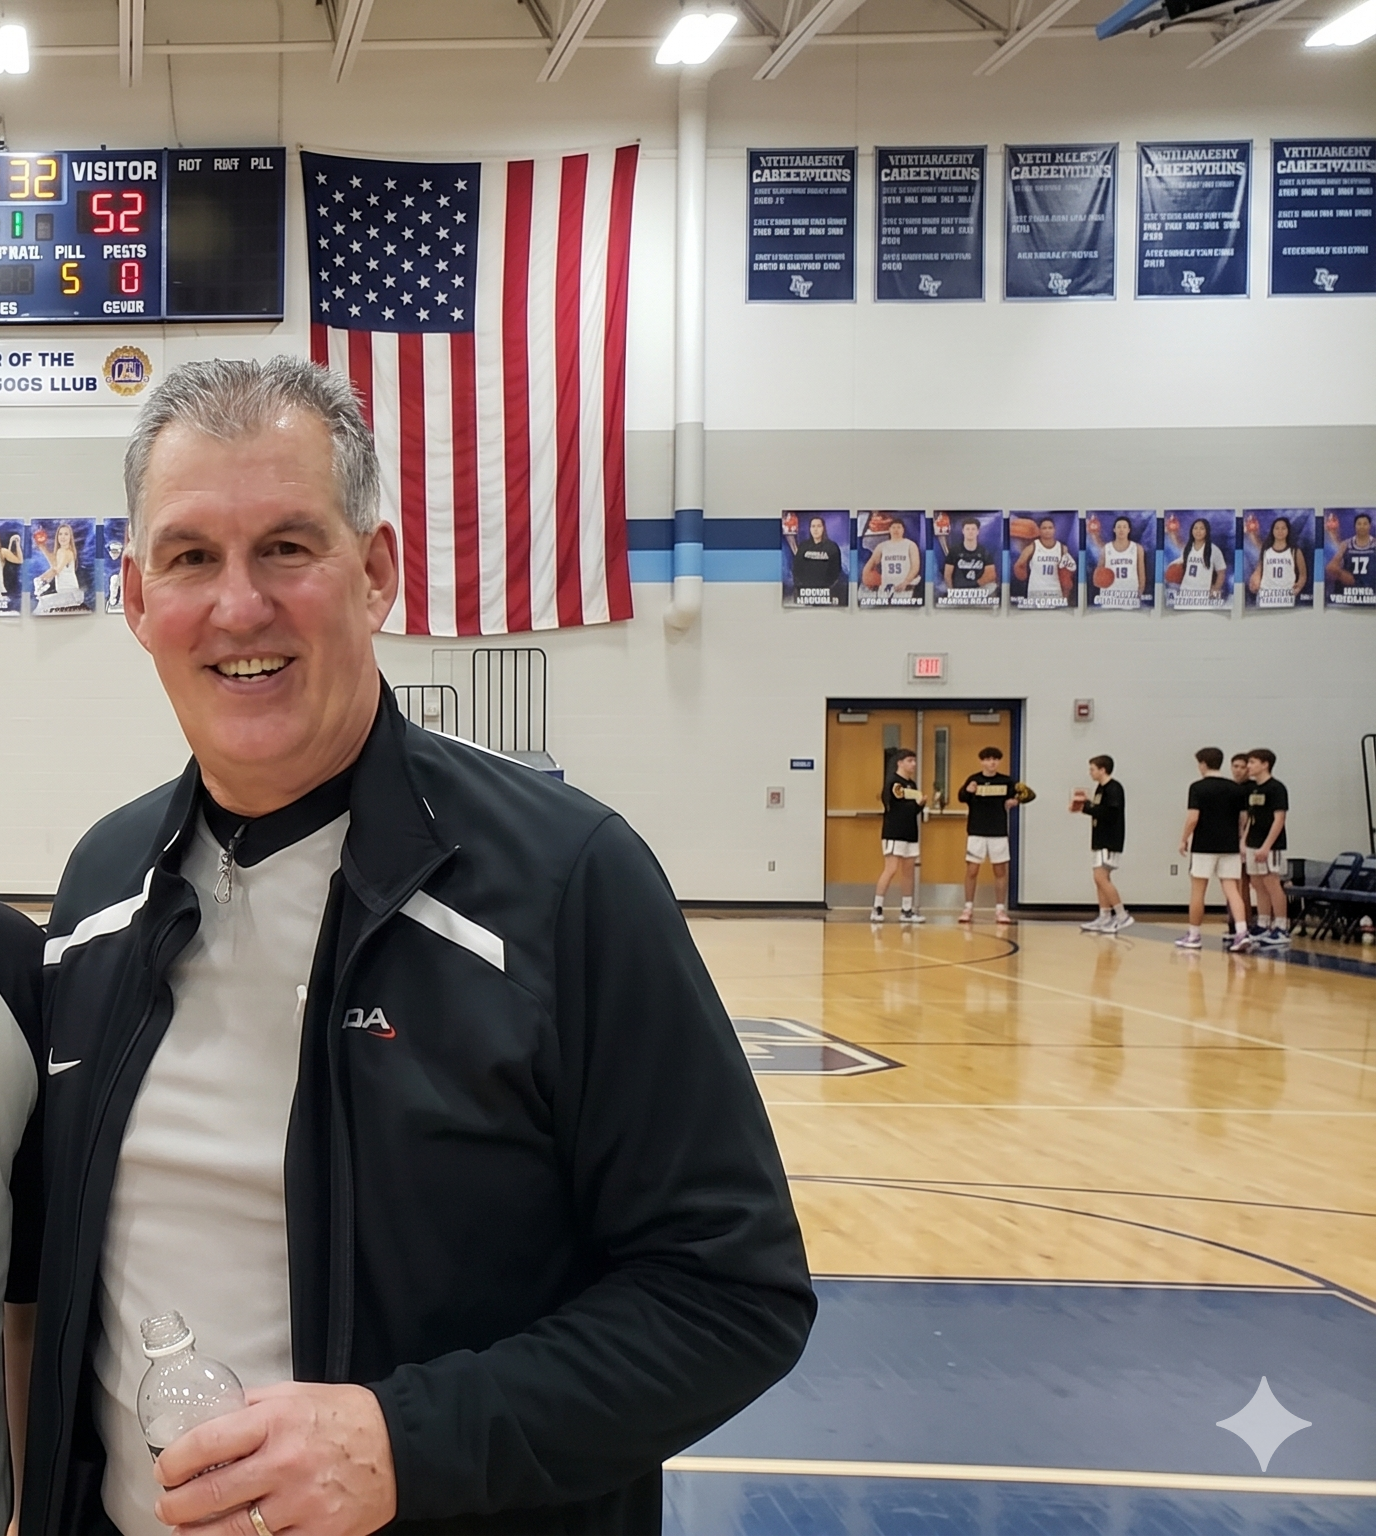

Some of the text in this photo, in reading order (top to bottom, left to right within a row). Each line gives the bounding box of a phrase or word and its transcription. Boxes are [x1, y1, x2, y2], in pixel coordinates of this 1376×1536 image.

[72, 161, 157, 181] VISITOR
[92, 193, 142, 233] 52
[55, 245, 85, 259] PILL
[62, 263, 80, 294] 5
[121, 263, 139, 293] 0
[9, 353, 32, 367] OF
[38, 353, 74, 367] THE
[50, 378, 97, 391] LLUB
